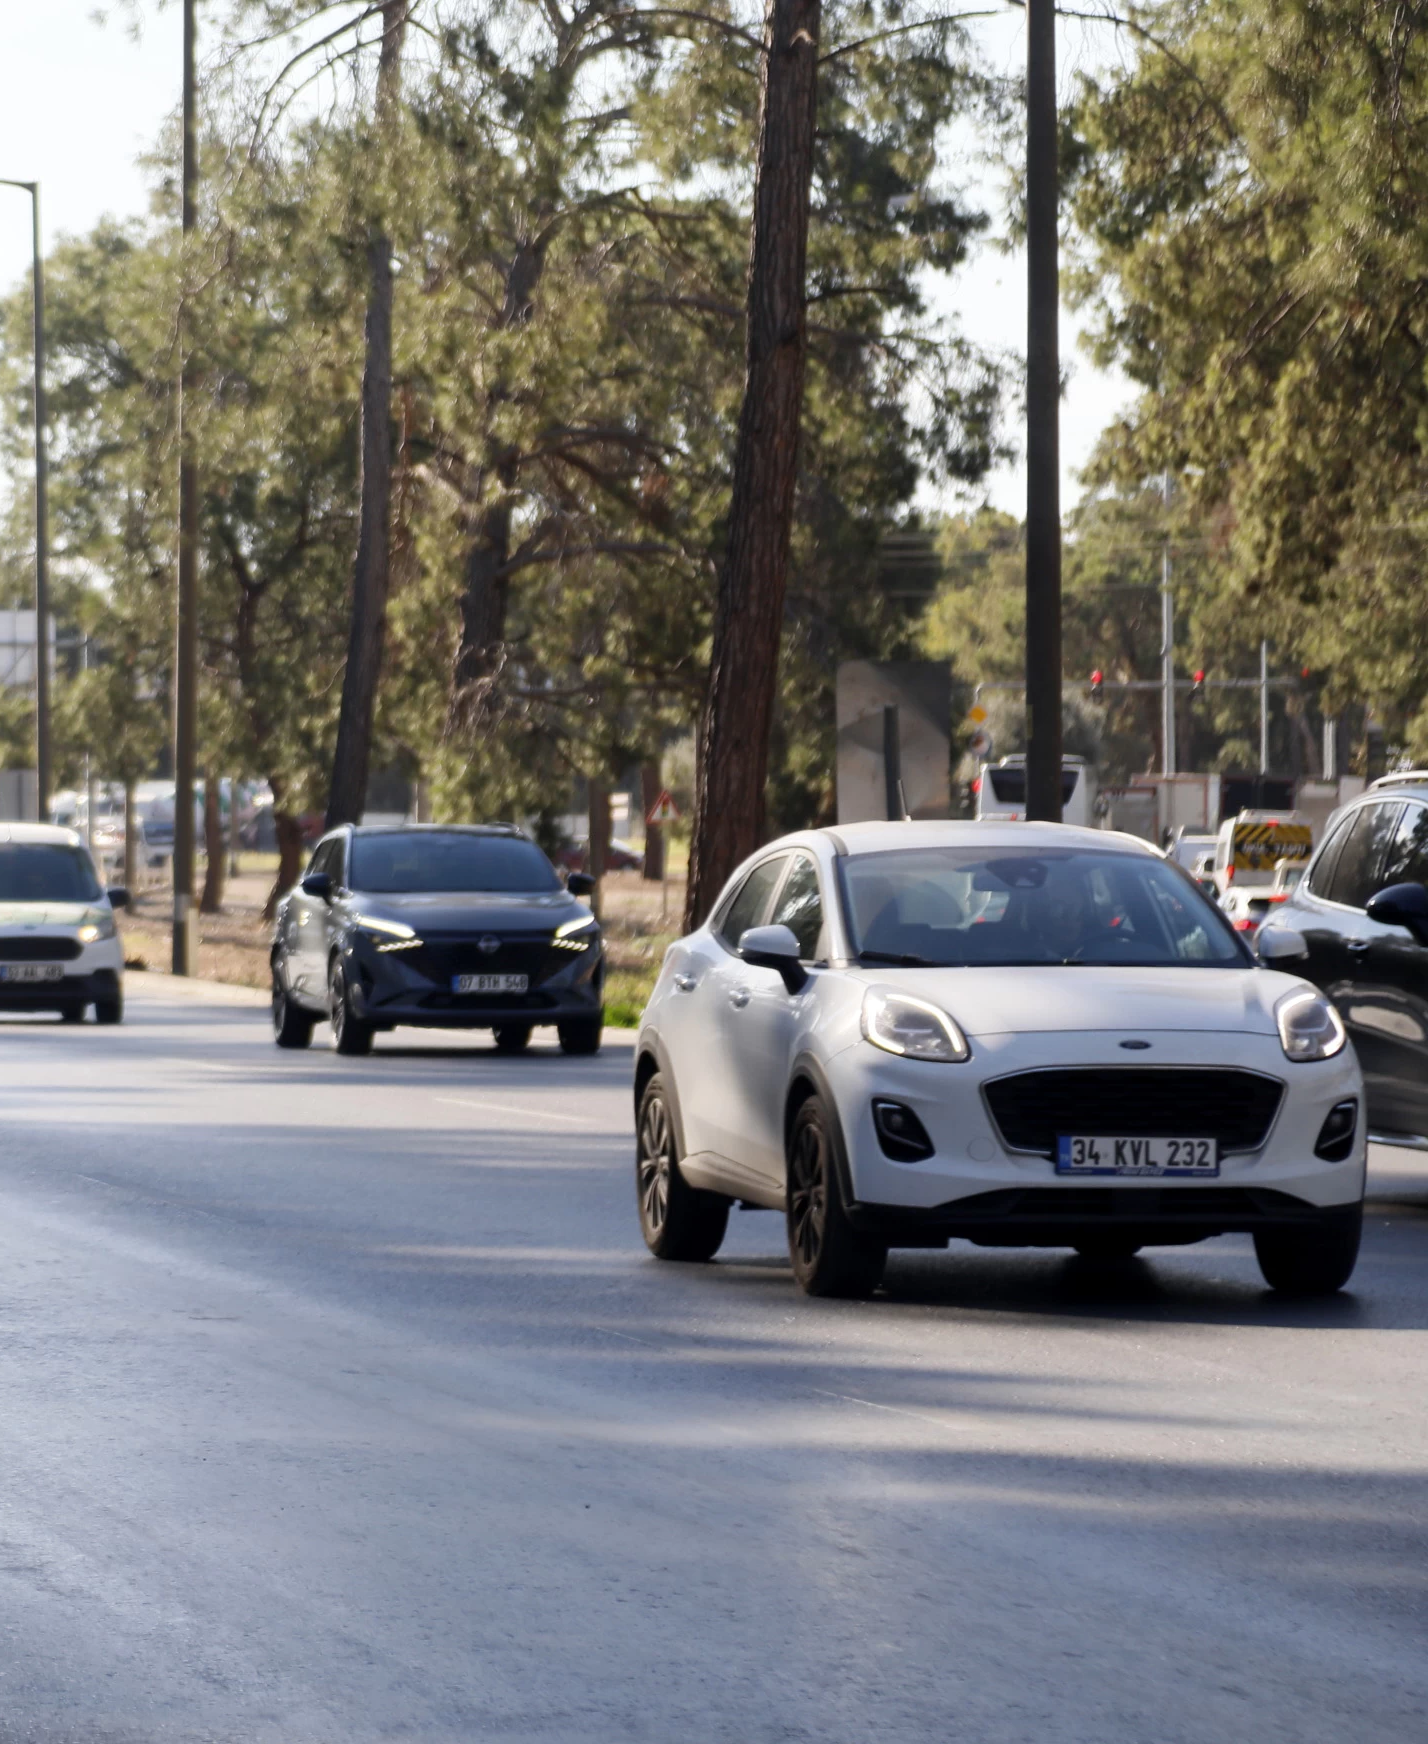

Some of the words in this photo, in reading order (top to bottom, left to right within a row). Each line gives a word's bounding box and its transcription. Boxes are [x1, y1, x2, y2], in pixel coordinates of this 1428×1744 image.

[460, 975, 473, 988] 07
[1073, 1139, 1100, 1165] 34
[1115, 1139, 1158, 1167] KVL
[1167, 1140, 1210, 1167] 232
